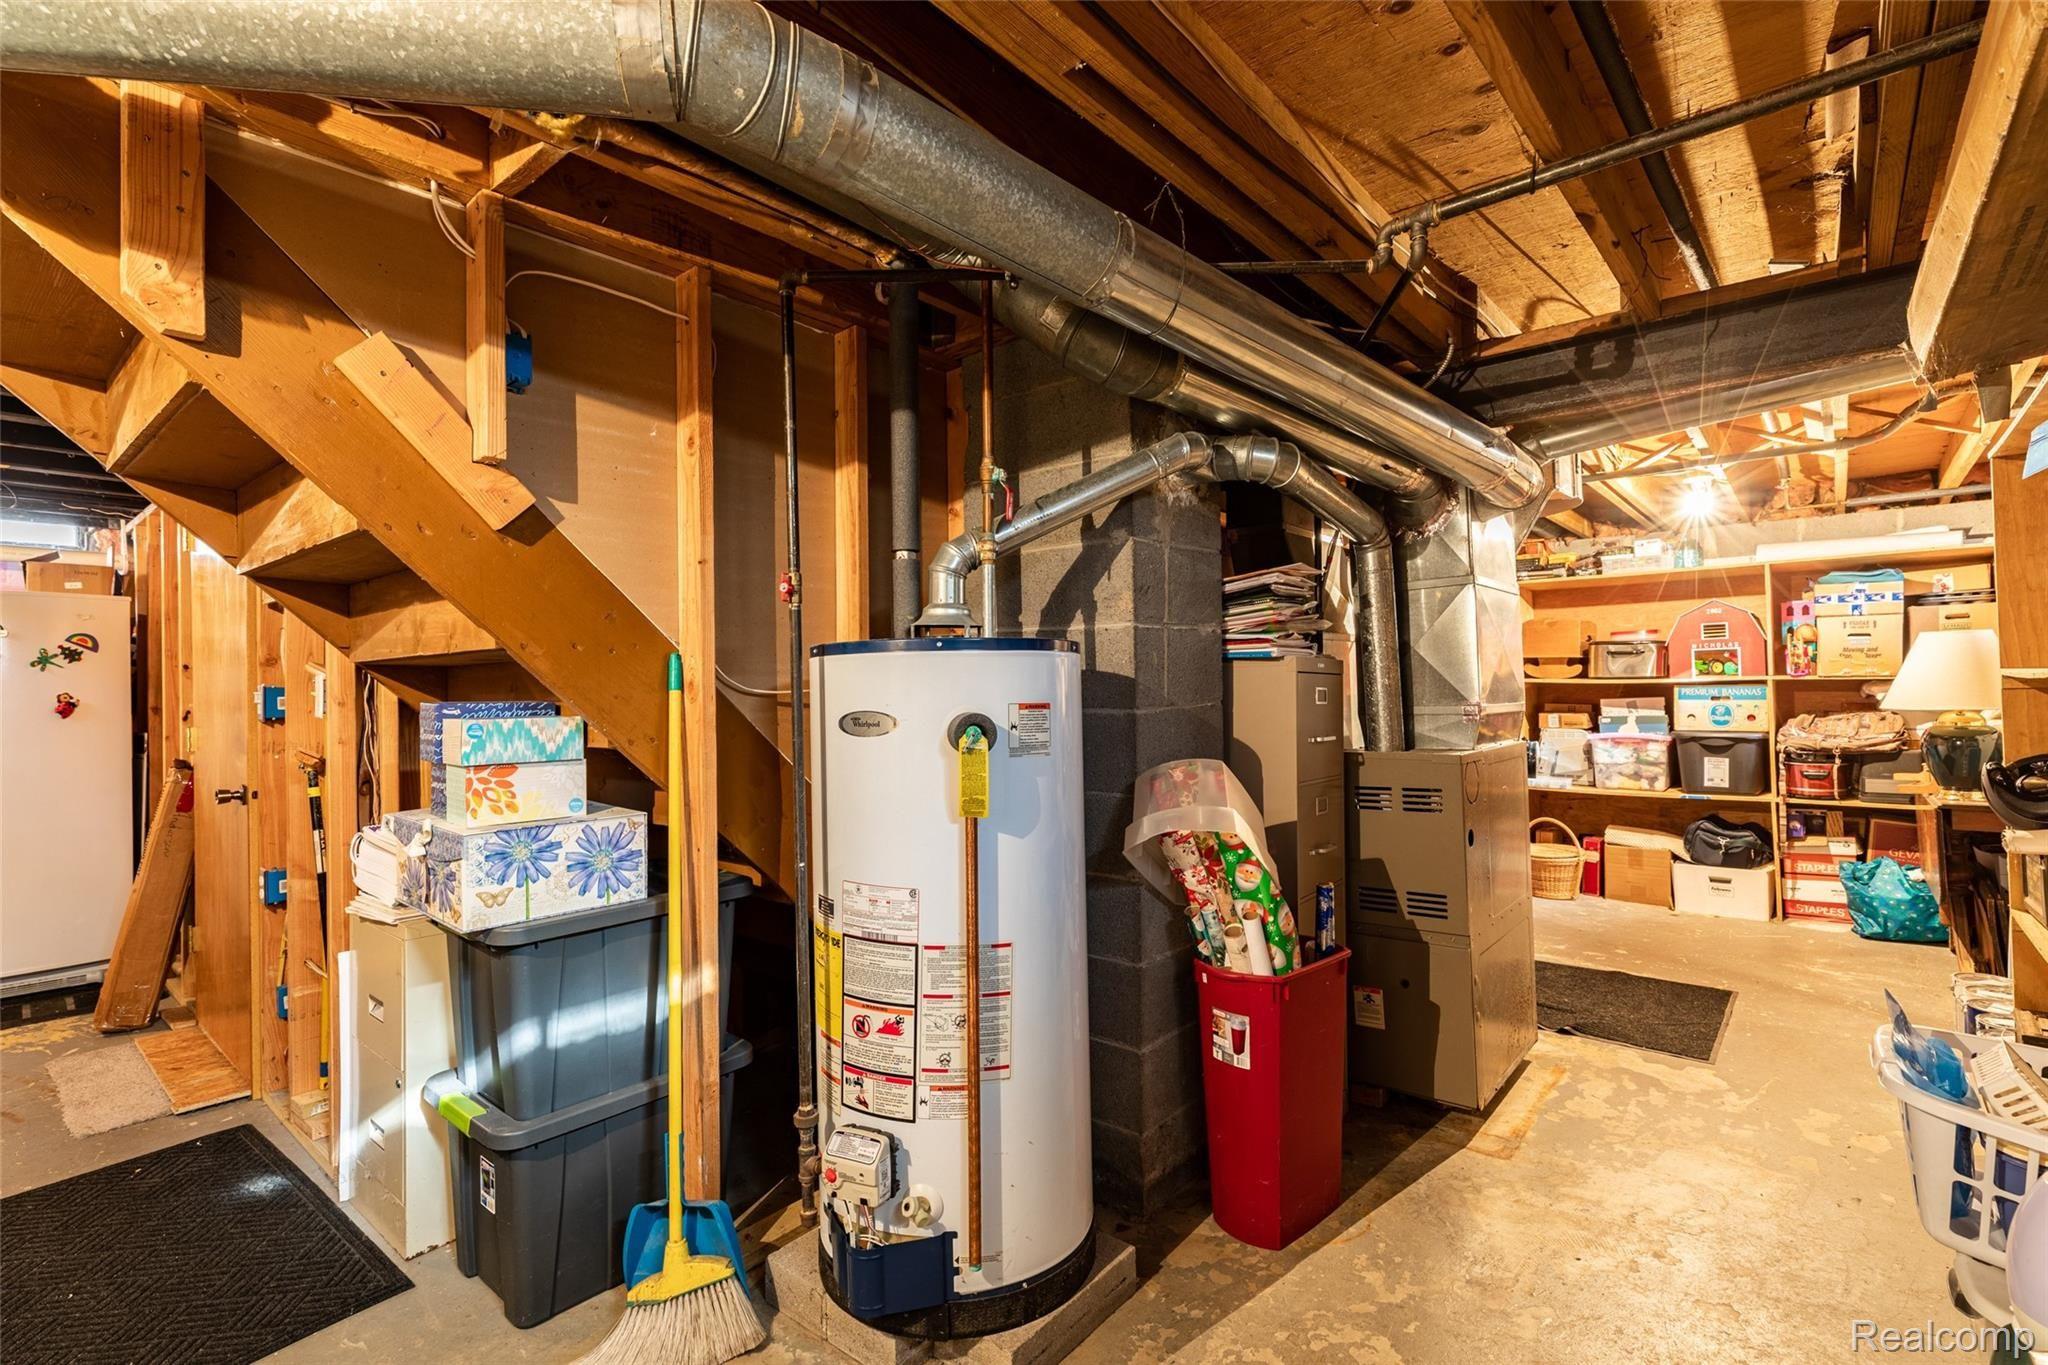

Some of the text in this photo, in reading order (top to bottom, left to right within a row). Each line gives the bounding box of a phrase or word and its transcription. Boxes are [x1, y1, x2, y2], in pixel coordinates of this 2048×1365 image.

[1680, 687, 1762, 696] PREMIUM BANANAS
[852, 720, 881, 729] Whirlpool
[1796, 904, 1846, 916] STAPLES
